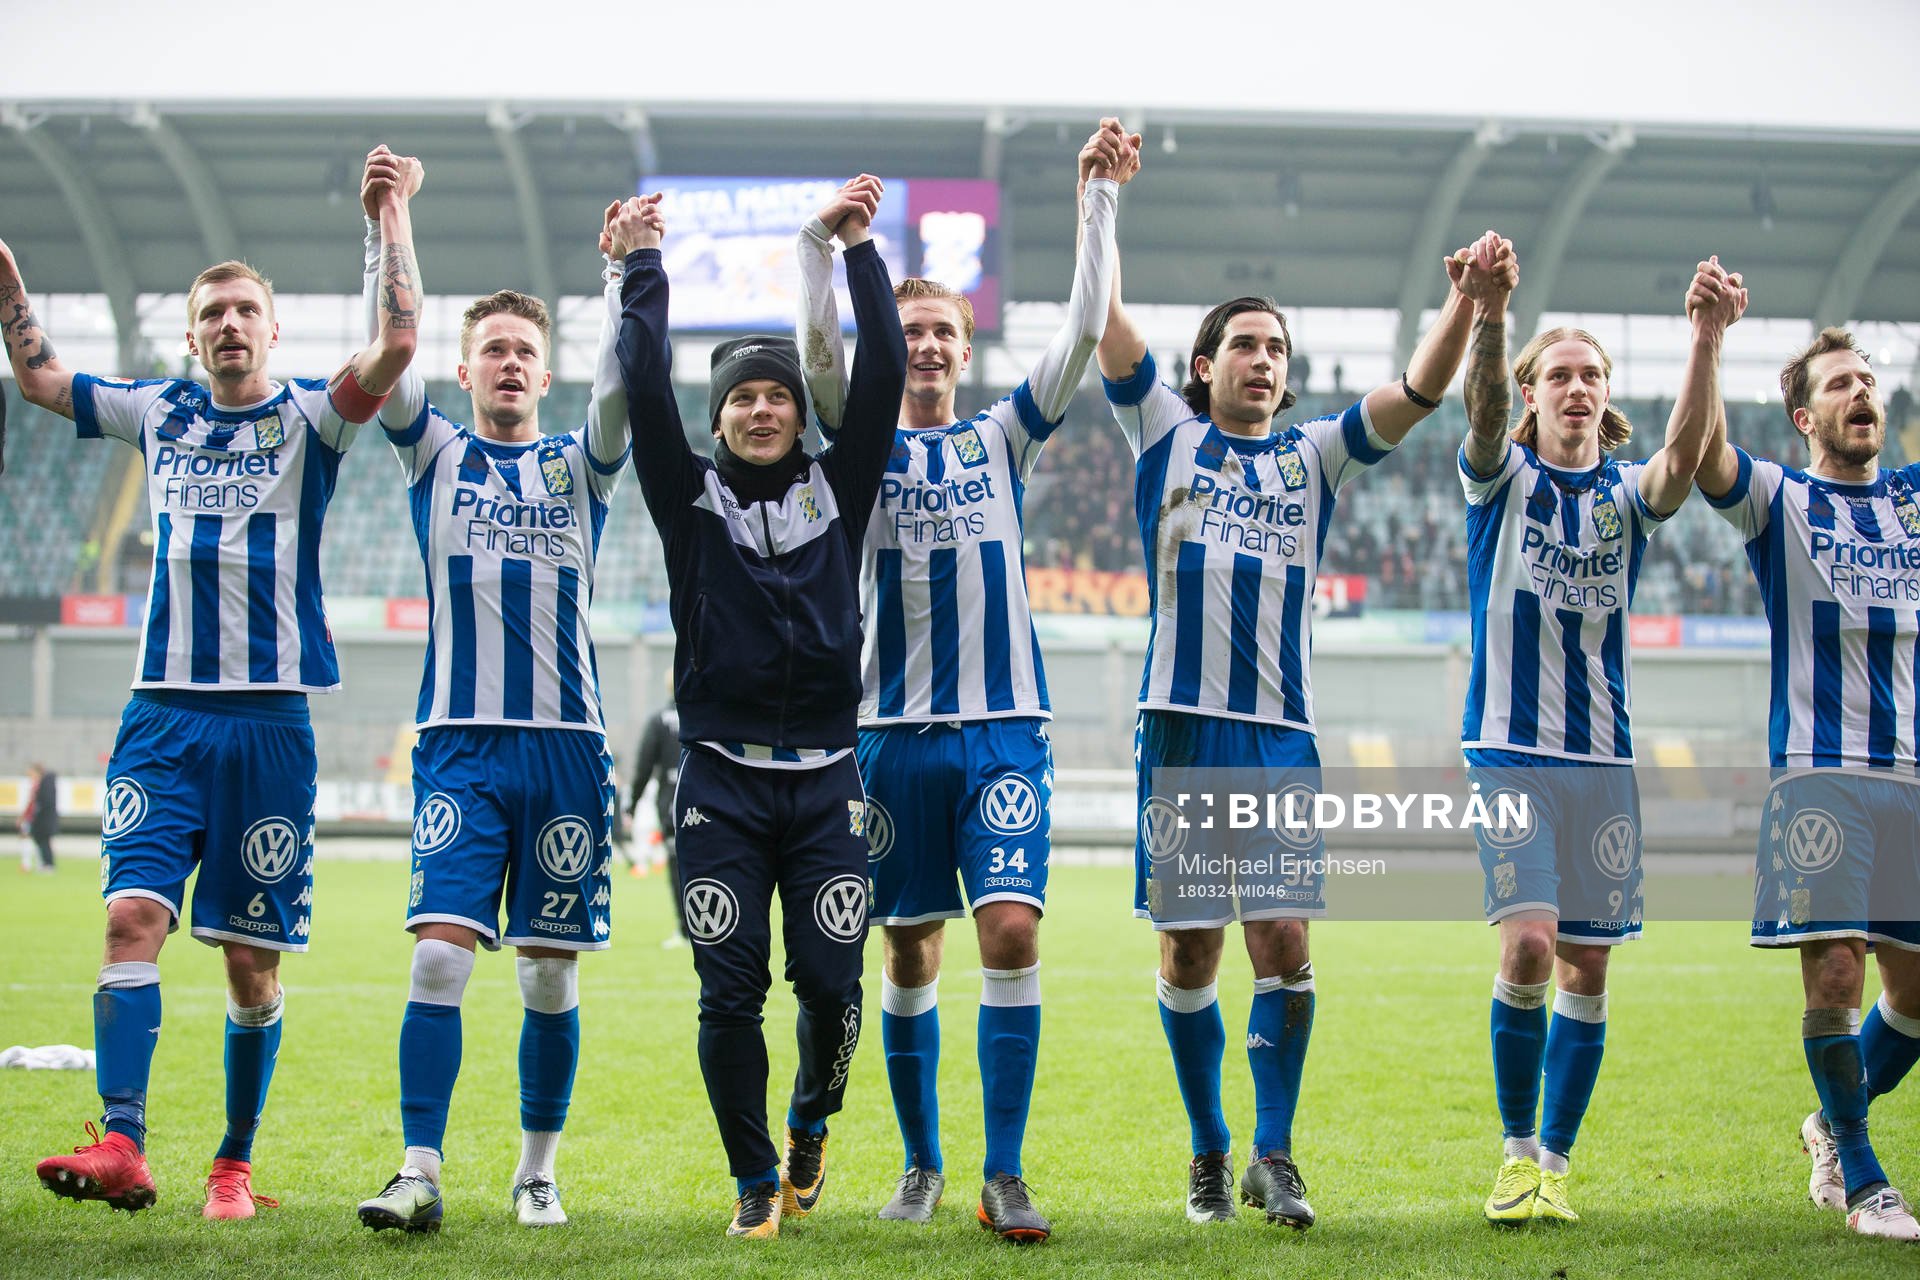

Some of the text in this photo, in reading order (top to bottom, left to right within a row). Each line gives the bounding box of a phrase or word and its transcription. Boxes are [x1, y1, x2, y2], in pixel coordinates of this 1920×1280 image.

[153, 446, 279, 476] Prioritet
[164, 477, 259, 508] Finans
[880, 471, 995, 512] Prioritet
[451, 488, 577, 528] Prioritet
[466, 520, 565, 557] Finans
[895, 511, 985, 543] Finans
[1201, 508, 1297, 557] Finans
[1810, 531, 1920, 570] Priorite
[1531, 562, 1617, 607] Finans
[1830, 564, 1920, 600] Finans
[988, 847, 1028, 873] 34
[984, 877, 1032, 888] Kappa
[1276, 889, 1315, 902] Kapp
[247, 892, 266, 918] 6
[541, 891, 579, 919] 27
[1608, 890, 1623, 916] 9
[229, 915, 279, 933] Kappa
[530, 918, 581, 934] Kappa
[1590, 917, 1626, 931] Kapp
